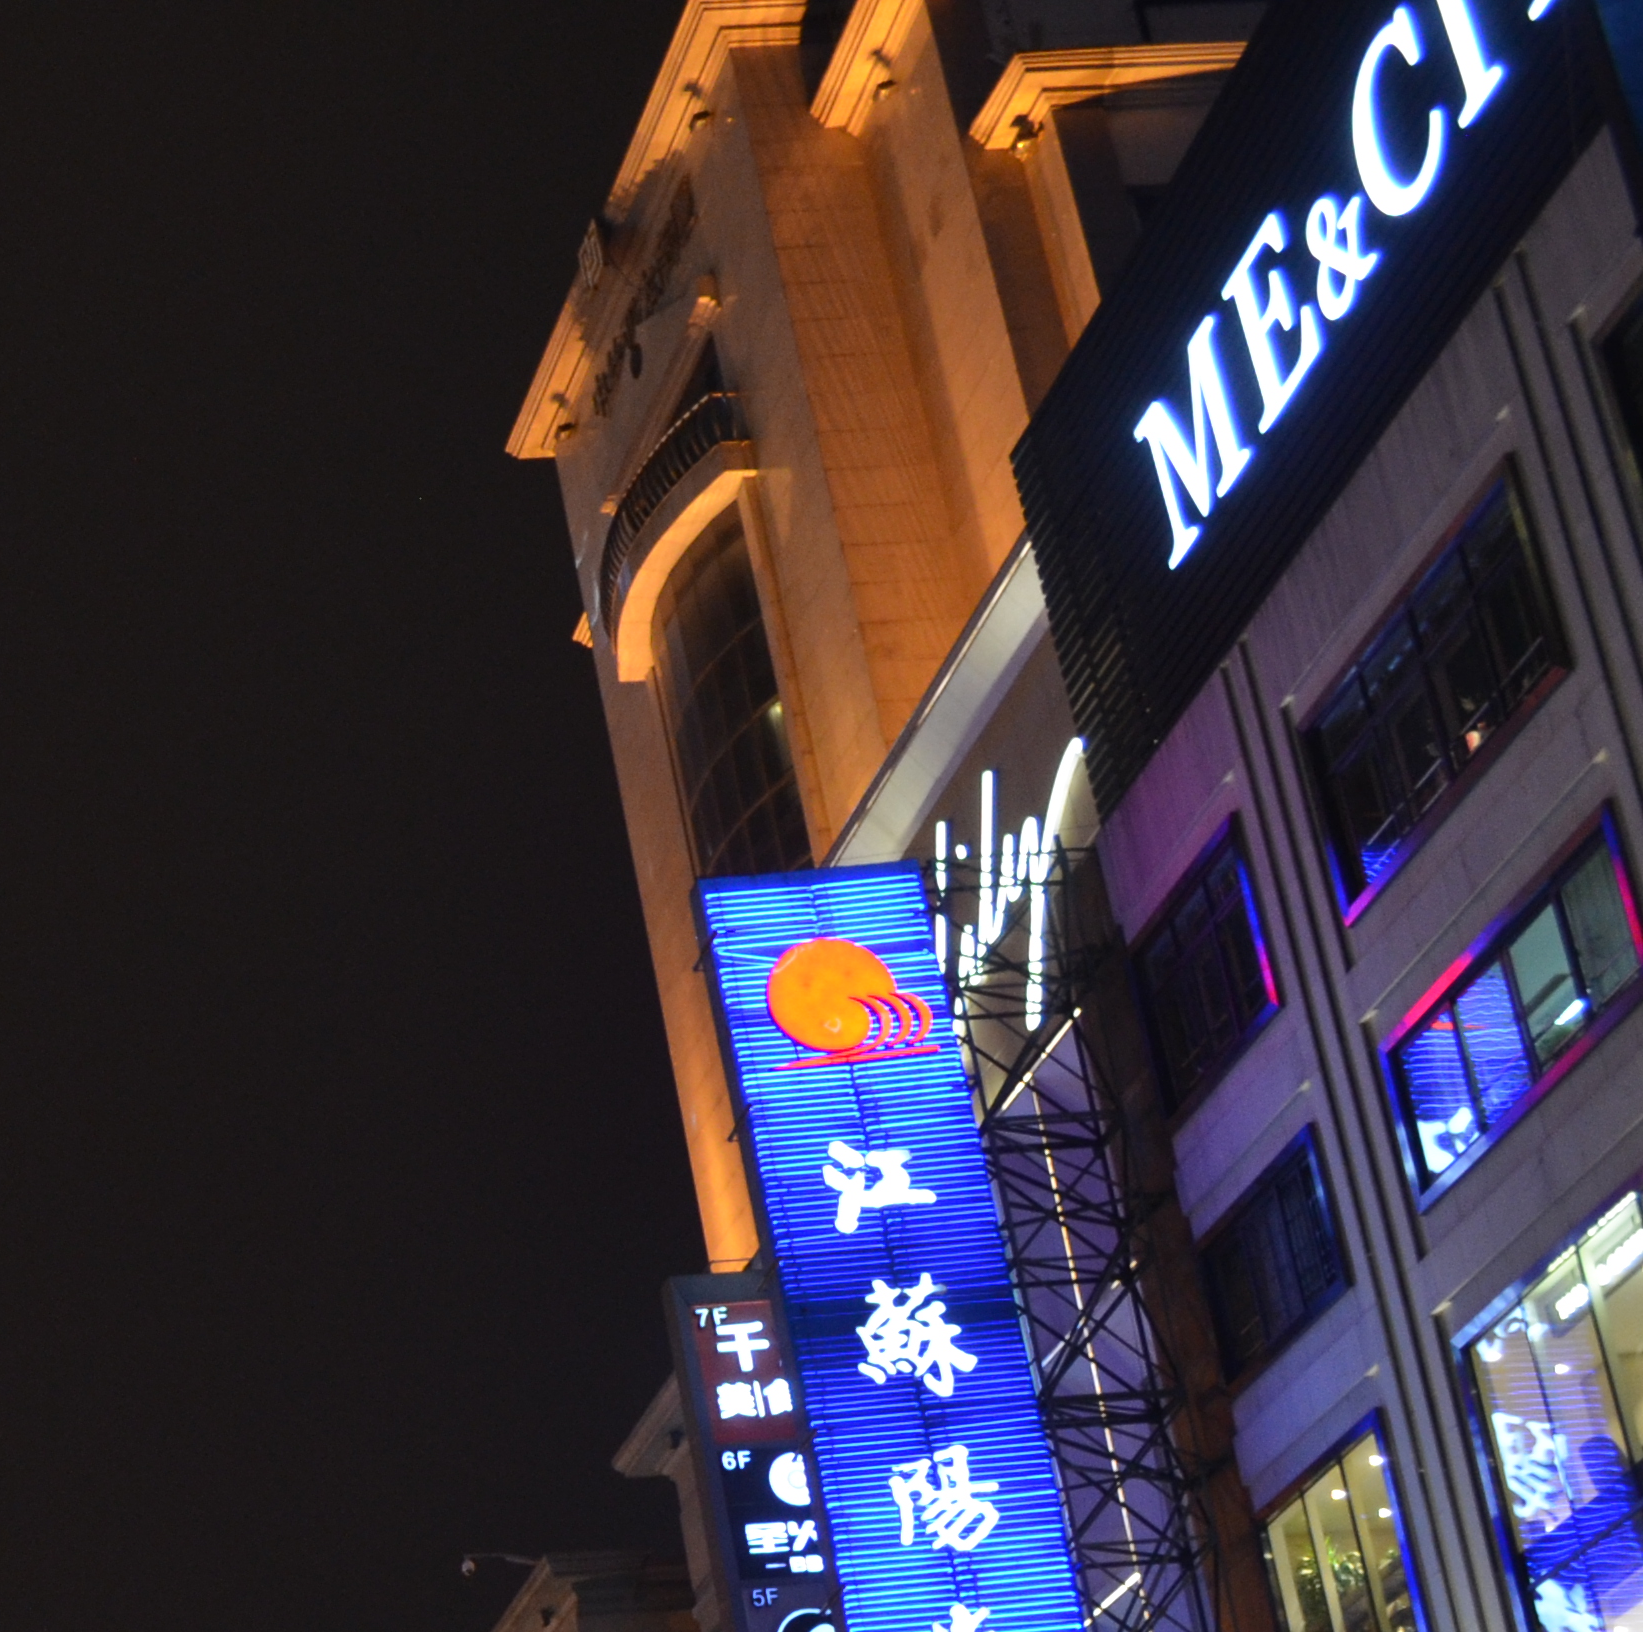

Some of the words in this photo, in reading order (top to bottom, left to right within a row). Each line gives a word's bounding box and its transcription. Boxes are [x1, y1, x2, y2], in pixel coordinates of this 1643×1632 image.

[1133, 0, 1555, 570] ME&CI
[694, 1307, 727, 1328] 7F
[721, 1450, 751, 1470] 6F
[752, 1588, 778, 1606] 5F
